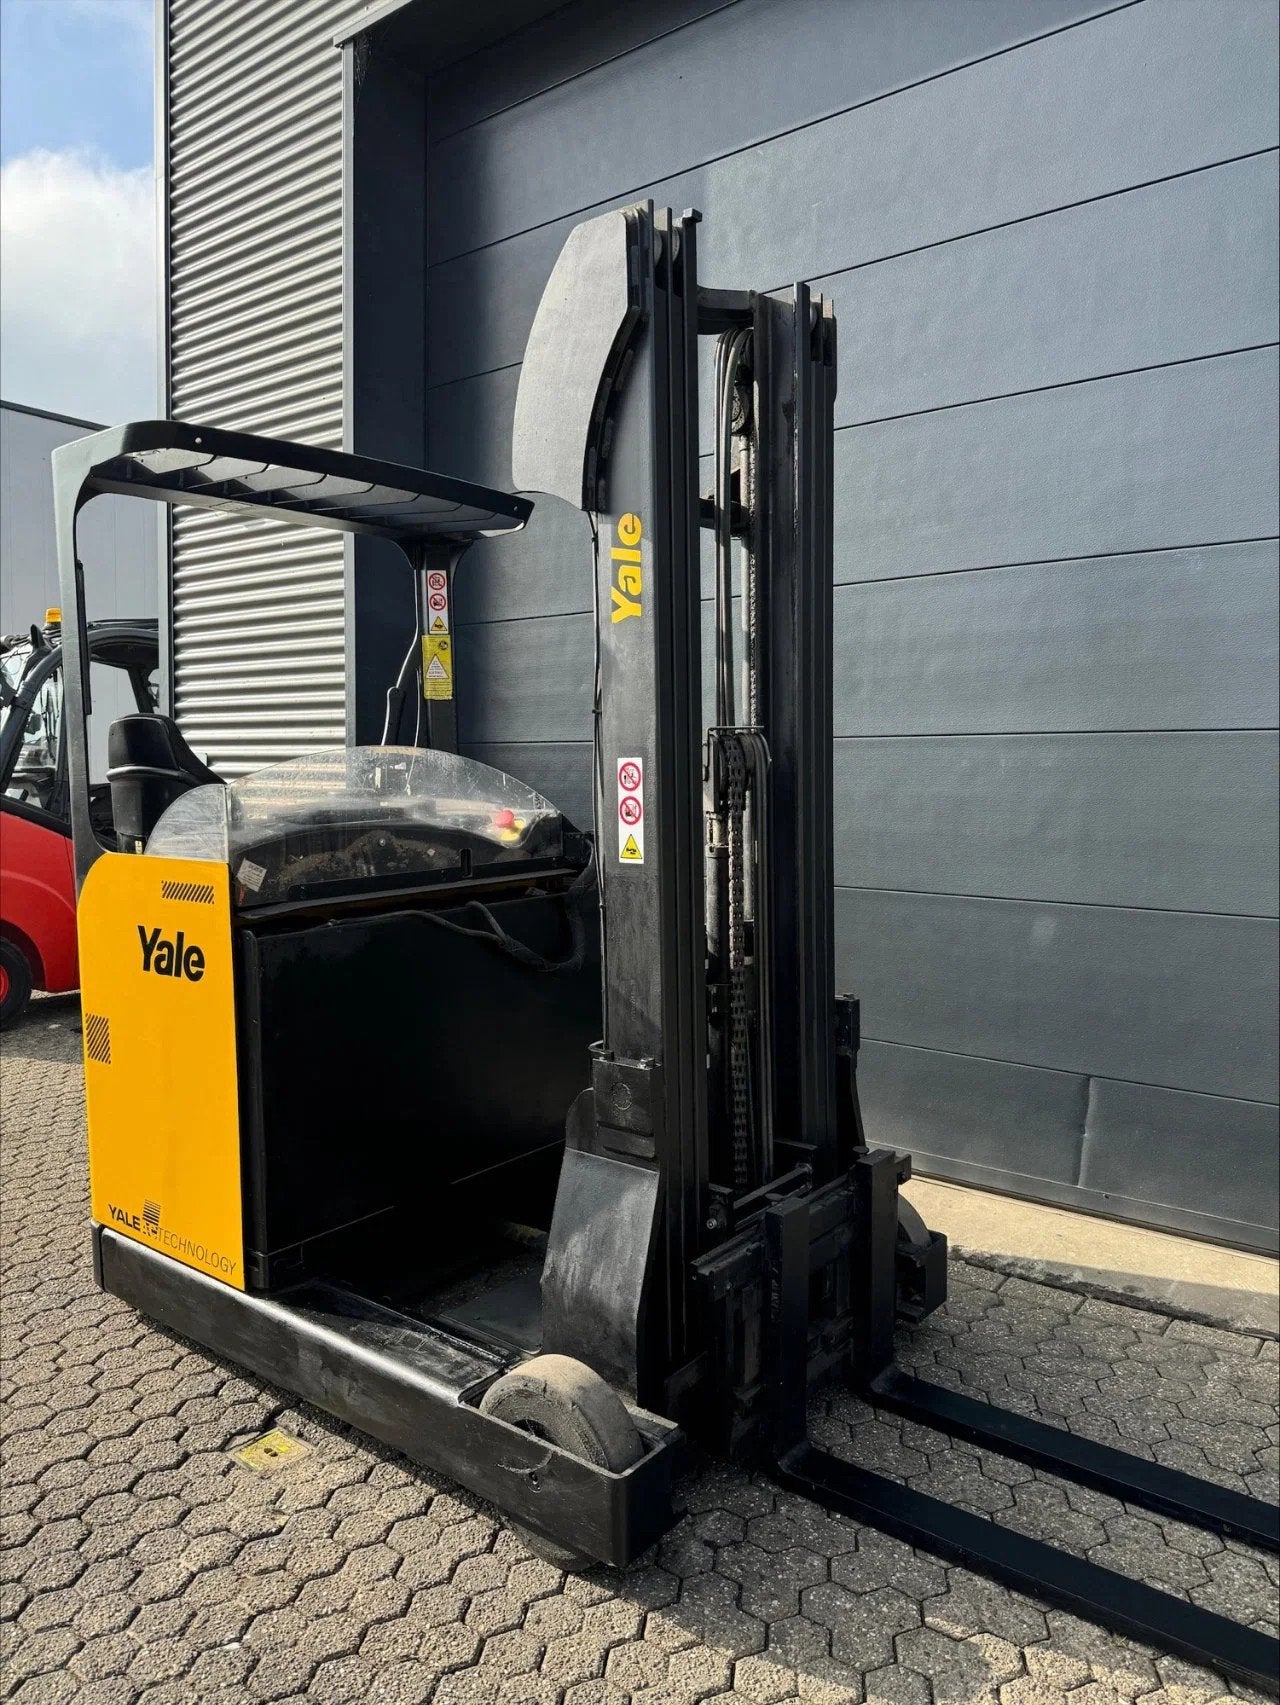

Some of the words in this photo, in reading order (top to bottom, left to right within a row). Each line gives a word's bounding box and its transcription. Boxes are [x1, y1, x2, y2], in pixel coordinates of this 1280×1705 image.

[611, 512, 641, 624] Yale
[137, 925, 205, 982] Yale
[108, 1204, 141, 1231] YALE
[158, 1227, 236, 1276] TECHNOLOGY
